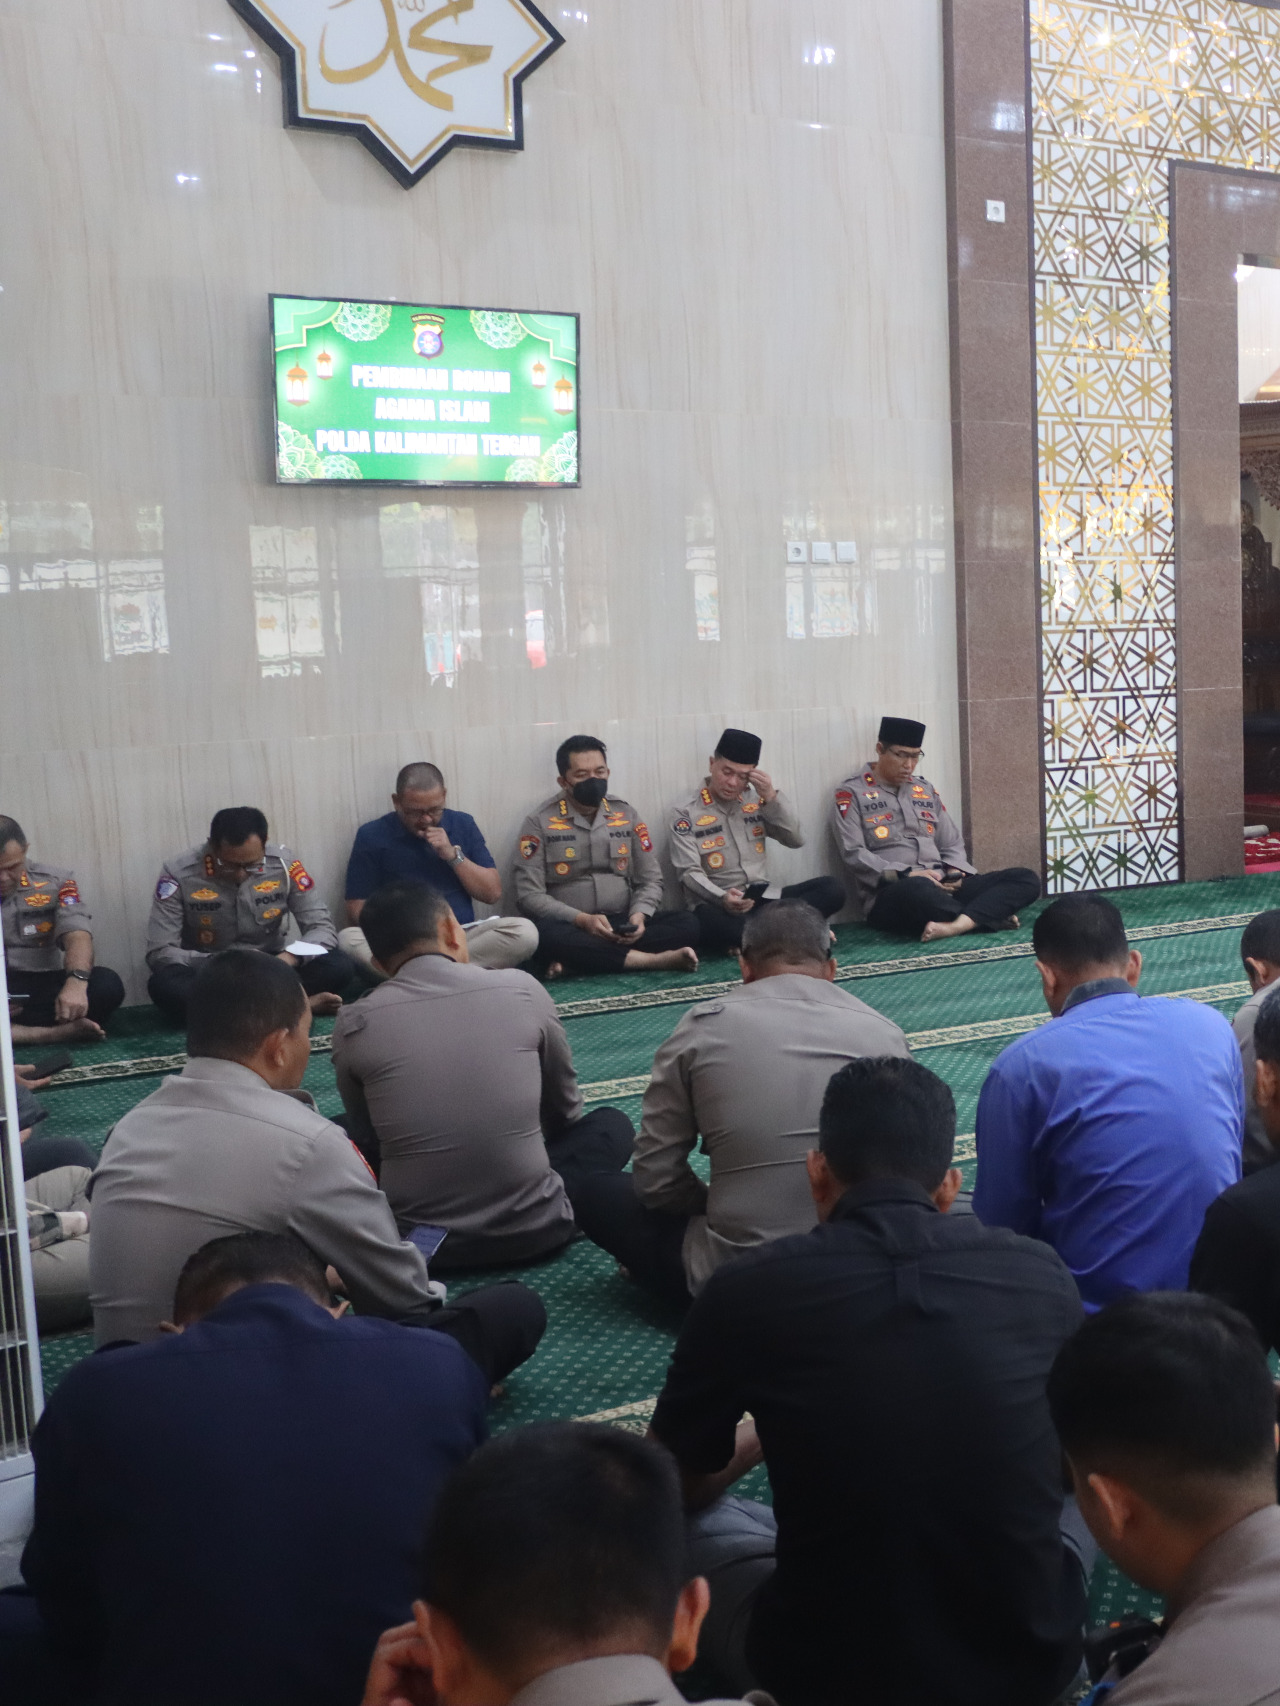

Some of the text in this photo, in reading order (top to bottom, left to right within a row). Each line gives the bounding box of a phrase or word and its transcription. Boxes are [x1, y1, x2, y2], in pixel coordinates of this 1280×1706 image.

[352, 364, 511, 393] PEMBINAAN ROHANI
[374, 397, 490, 423] AGAMA ISLAM
[316, 429, 541, 457] POLDA KALIMANTAN TENGAH
